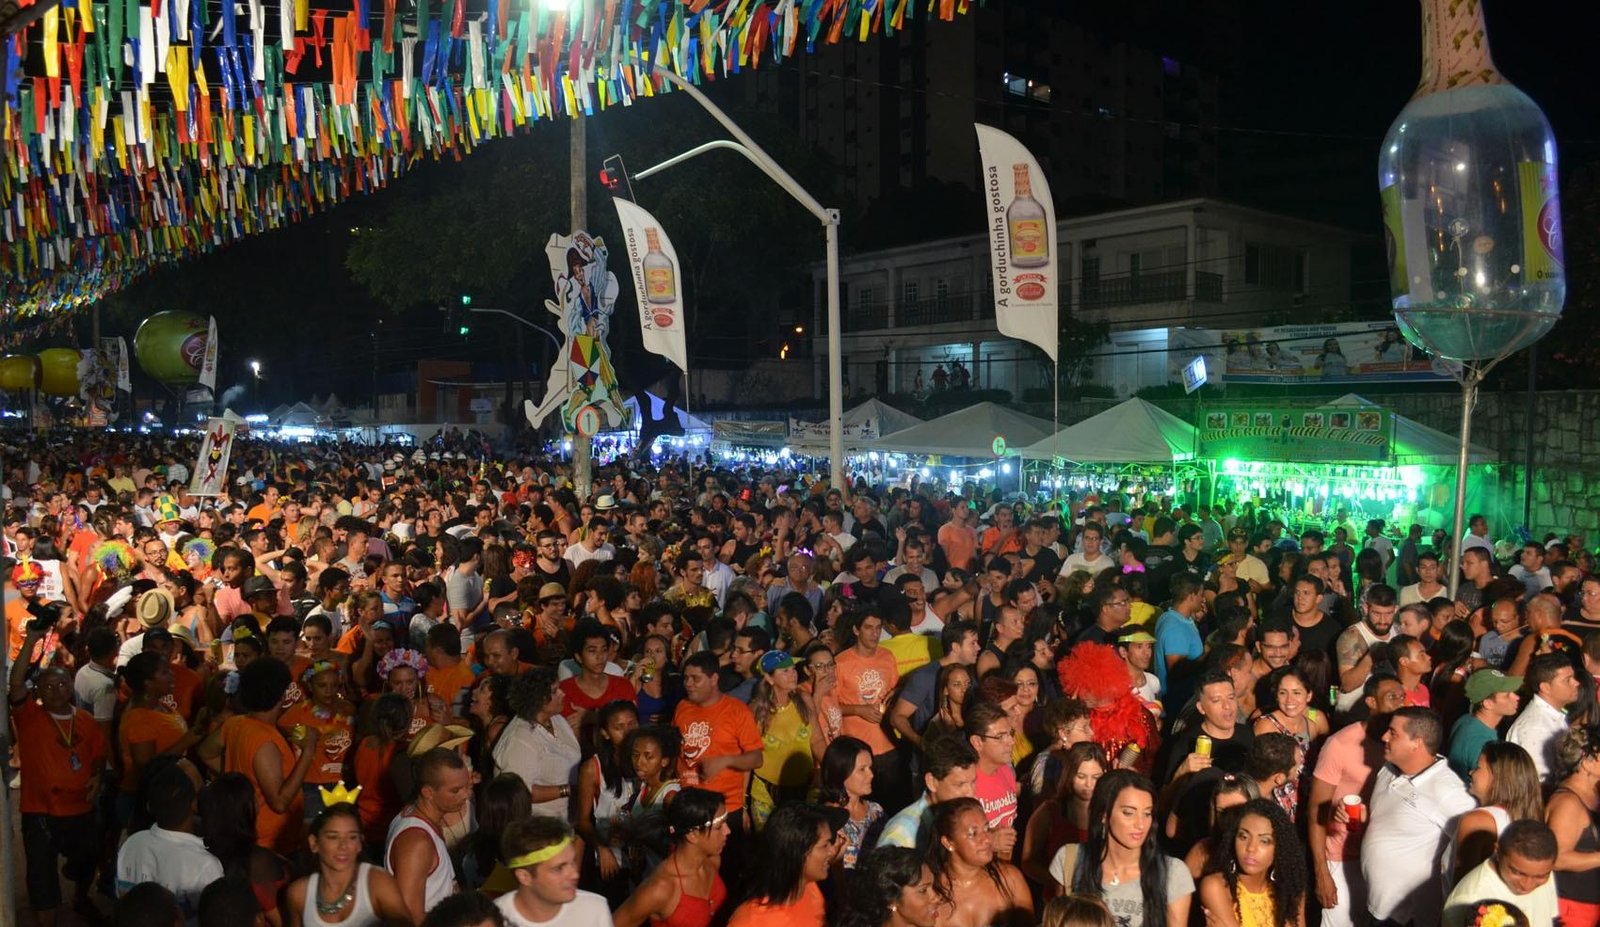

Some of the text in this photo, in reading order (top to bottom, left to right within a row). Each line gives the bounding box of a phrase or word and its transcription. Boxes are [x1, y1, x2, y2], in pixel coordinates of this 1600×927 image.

[626, 227, 642, 263] gostosa
[989, 165, 1011, 308] A gorduchinha gostosa
